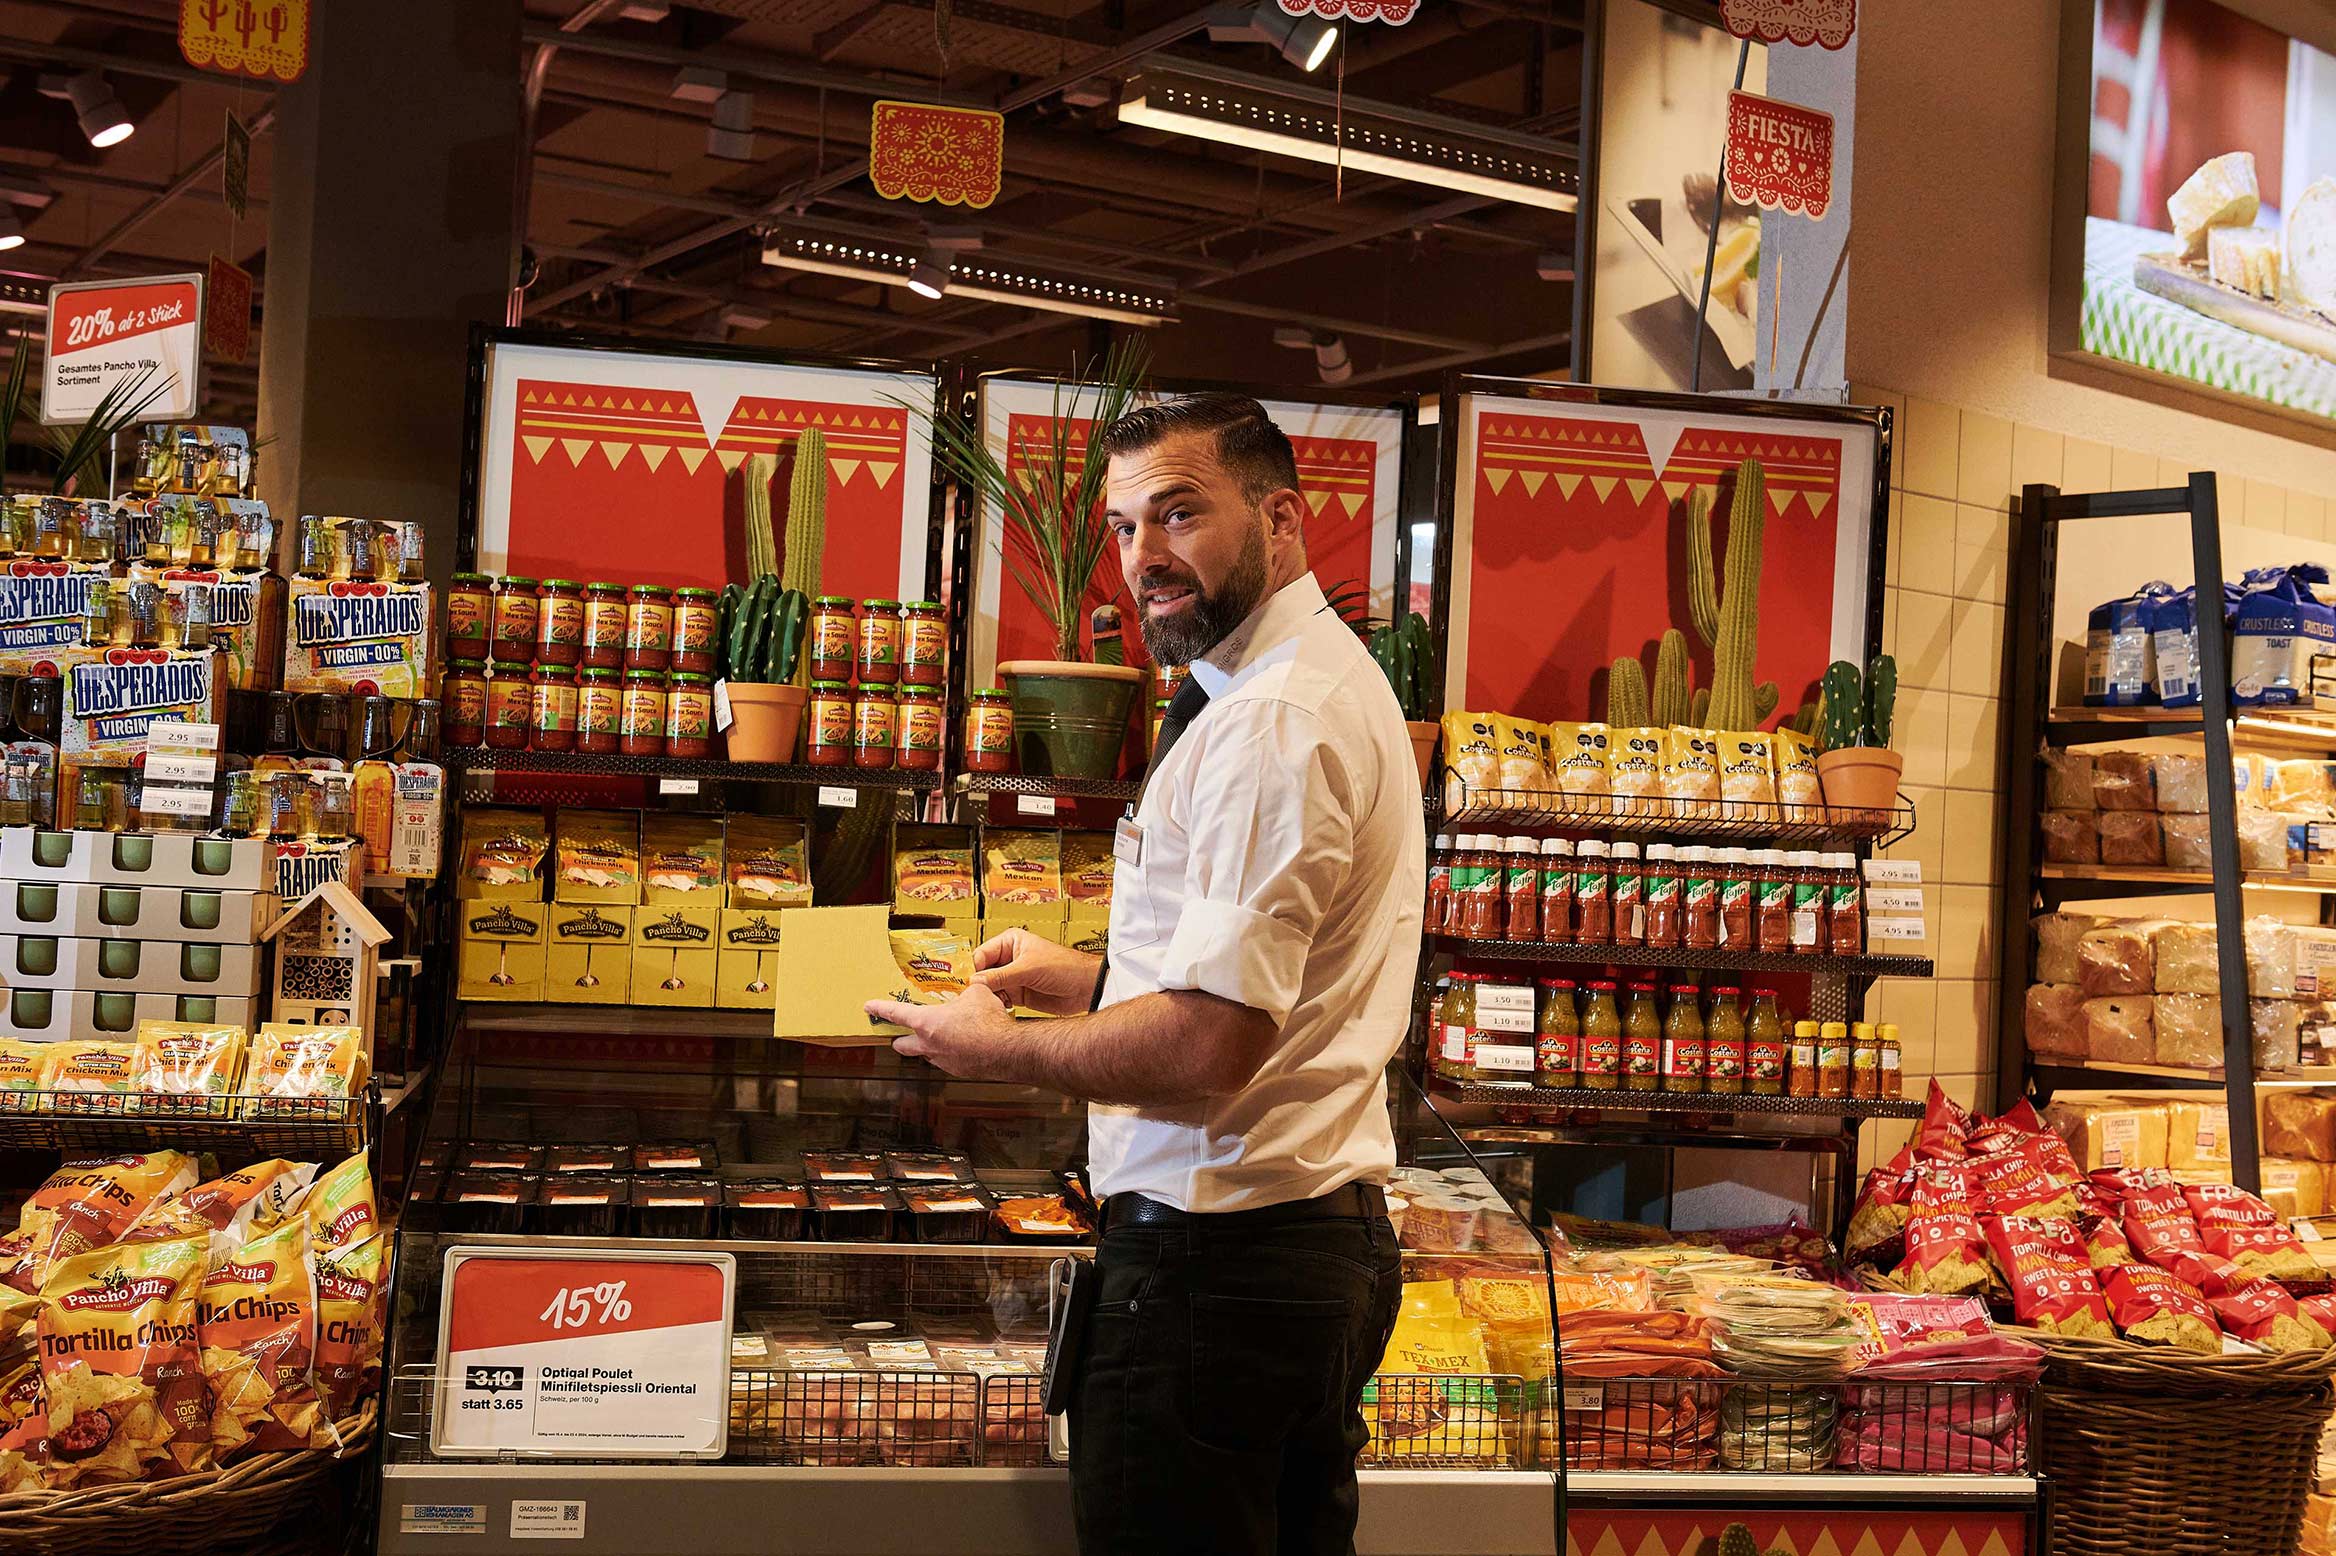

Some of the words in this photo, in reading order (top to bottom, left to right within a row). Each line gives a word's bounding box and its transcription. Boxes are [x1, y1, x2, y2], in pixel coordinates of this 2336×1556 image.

[1748, 114, 1815, 153] FIESTA
[66, 307, 115, 345] 20%
[118, 310, 136, 332] ab
[136, 311, 145, 328] 2
[148, 299, 183, 324] Stück
[58, 362, 101, 374] Gesamtes
[104, 359, 135, 371] Pancho
[138, 359, 156, 368] Villa
[57, 376, 100, 386] Sortiment
[301, 597, 421, 640] DESPERADOS
[3, 628, 47, 645] VIRGIN
[2266, 639, 2292, 648] TOAST
[323, 647, 368, 664] VIRGIN
[77, 663, 205, 713] DESPERADOS
[100, 720, 148, 737] VIRGIN
[168, 733, 188, 742] 2.95
[165, 766, 185, 774] 2.95
[400, 776, 438, 791] DESPERADOS
[161, 800, 182, 808] 2.95
[280, 857, 339, 898] RADOS
[1004, 873, 1043, 882] Mexican
[476, 920, 510, 930] Pancho
[511, 920, 533, 933] Villa
[563, 923, 597, 933] Pancho
[599, 923, 620, 935] Villa
[648, 926, 682, 937] Pancho
[683, 926, 704, 938] Villa
[732, 931, 766, 940] Pancho
[767, 931, 780, 940] Vil
[75, 1053, 107, 1062] Pancho
[66, 1067, 108, 1075] Chicken
[110, 1069, 129, 1077] Mix
[78, 1174, 135, 1207] Chips
[1941, 1191, 1967, 1203] CHIPS
[69, 1201, 100, 1220] Ranch
[2210, 1207, 2254, 1223] TORTILLA
[337, 1208, 368, 1233] Villa
[2010, 1242, 2053, 1260] TORTILLA
[234, 1265, 266, 1281] Villa
[2023, 1270, 2050, 1287] SWEET
[67, 1287, 128, 1306] Pancho
[131, 1279, 168, 1298] Villa
[337, 1279, 368, 1298] Villa
[2136, 1284, 2162, 1294] SWEET
[234, 1294, 300, 1322] Chips
[539, 1280, 632, 1329] 15%
[42, 1328, 133, 1357] Tortilla
[137, 1319, 197, 1346] Chips
[254, 1336, 290, 1350] Ranch
[1400, 1351, 1430, 1364] TEX
[1438, 1356, 1470, 1368] MEX
[157, 1366, 185, 1378] Ranch
[474, 1370, 515, 1387] 3.10
[592, 1368, 633, 1379] Poulet
[540, 1380, 642, 1396] Minifiletspiessli
[645, 1383, 696, 1394] Oriental
[461, 1399, 491, 1410] statt
[493, 1400, 523, 1410] 3.65
[540, 1395, 567, 1403] Schweiz,
[1581, 1397, 1600, 1405] 3.80
[179, 1415, 197, 1423] corn
